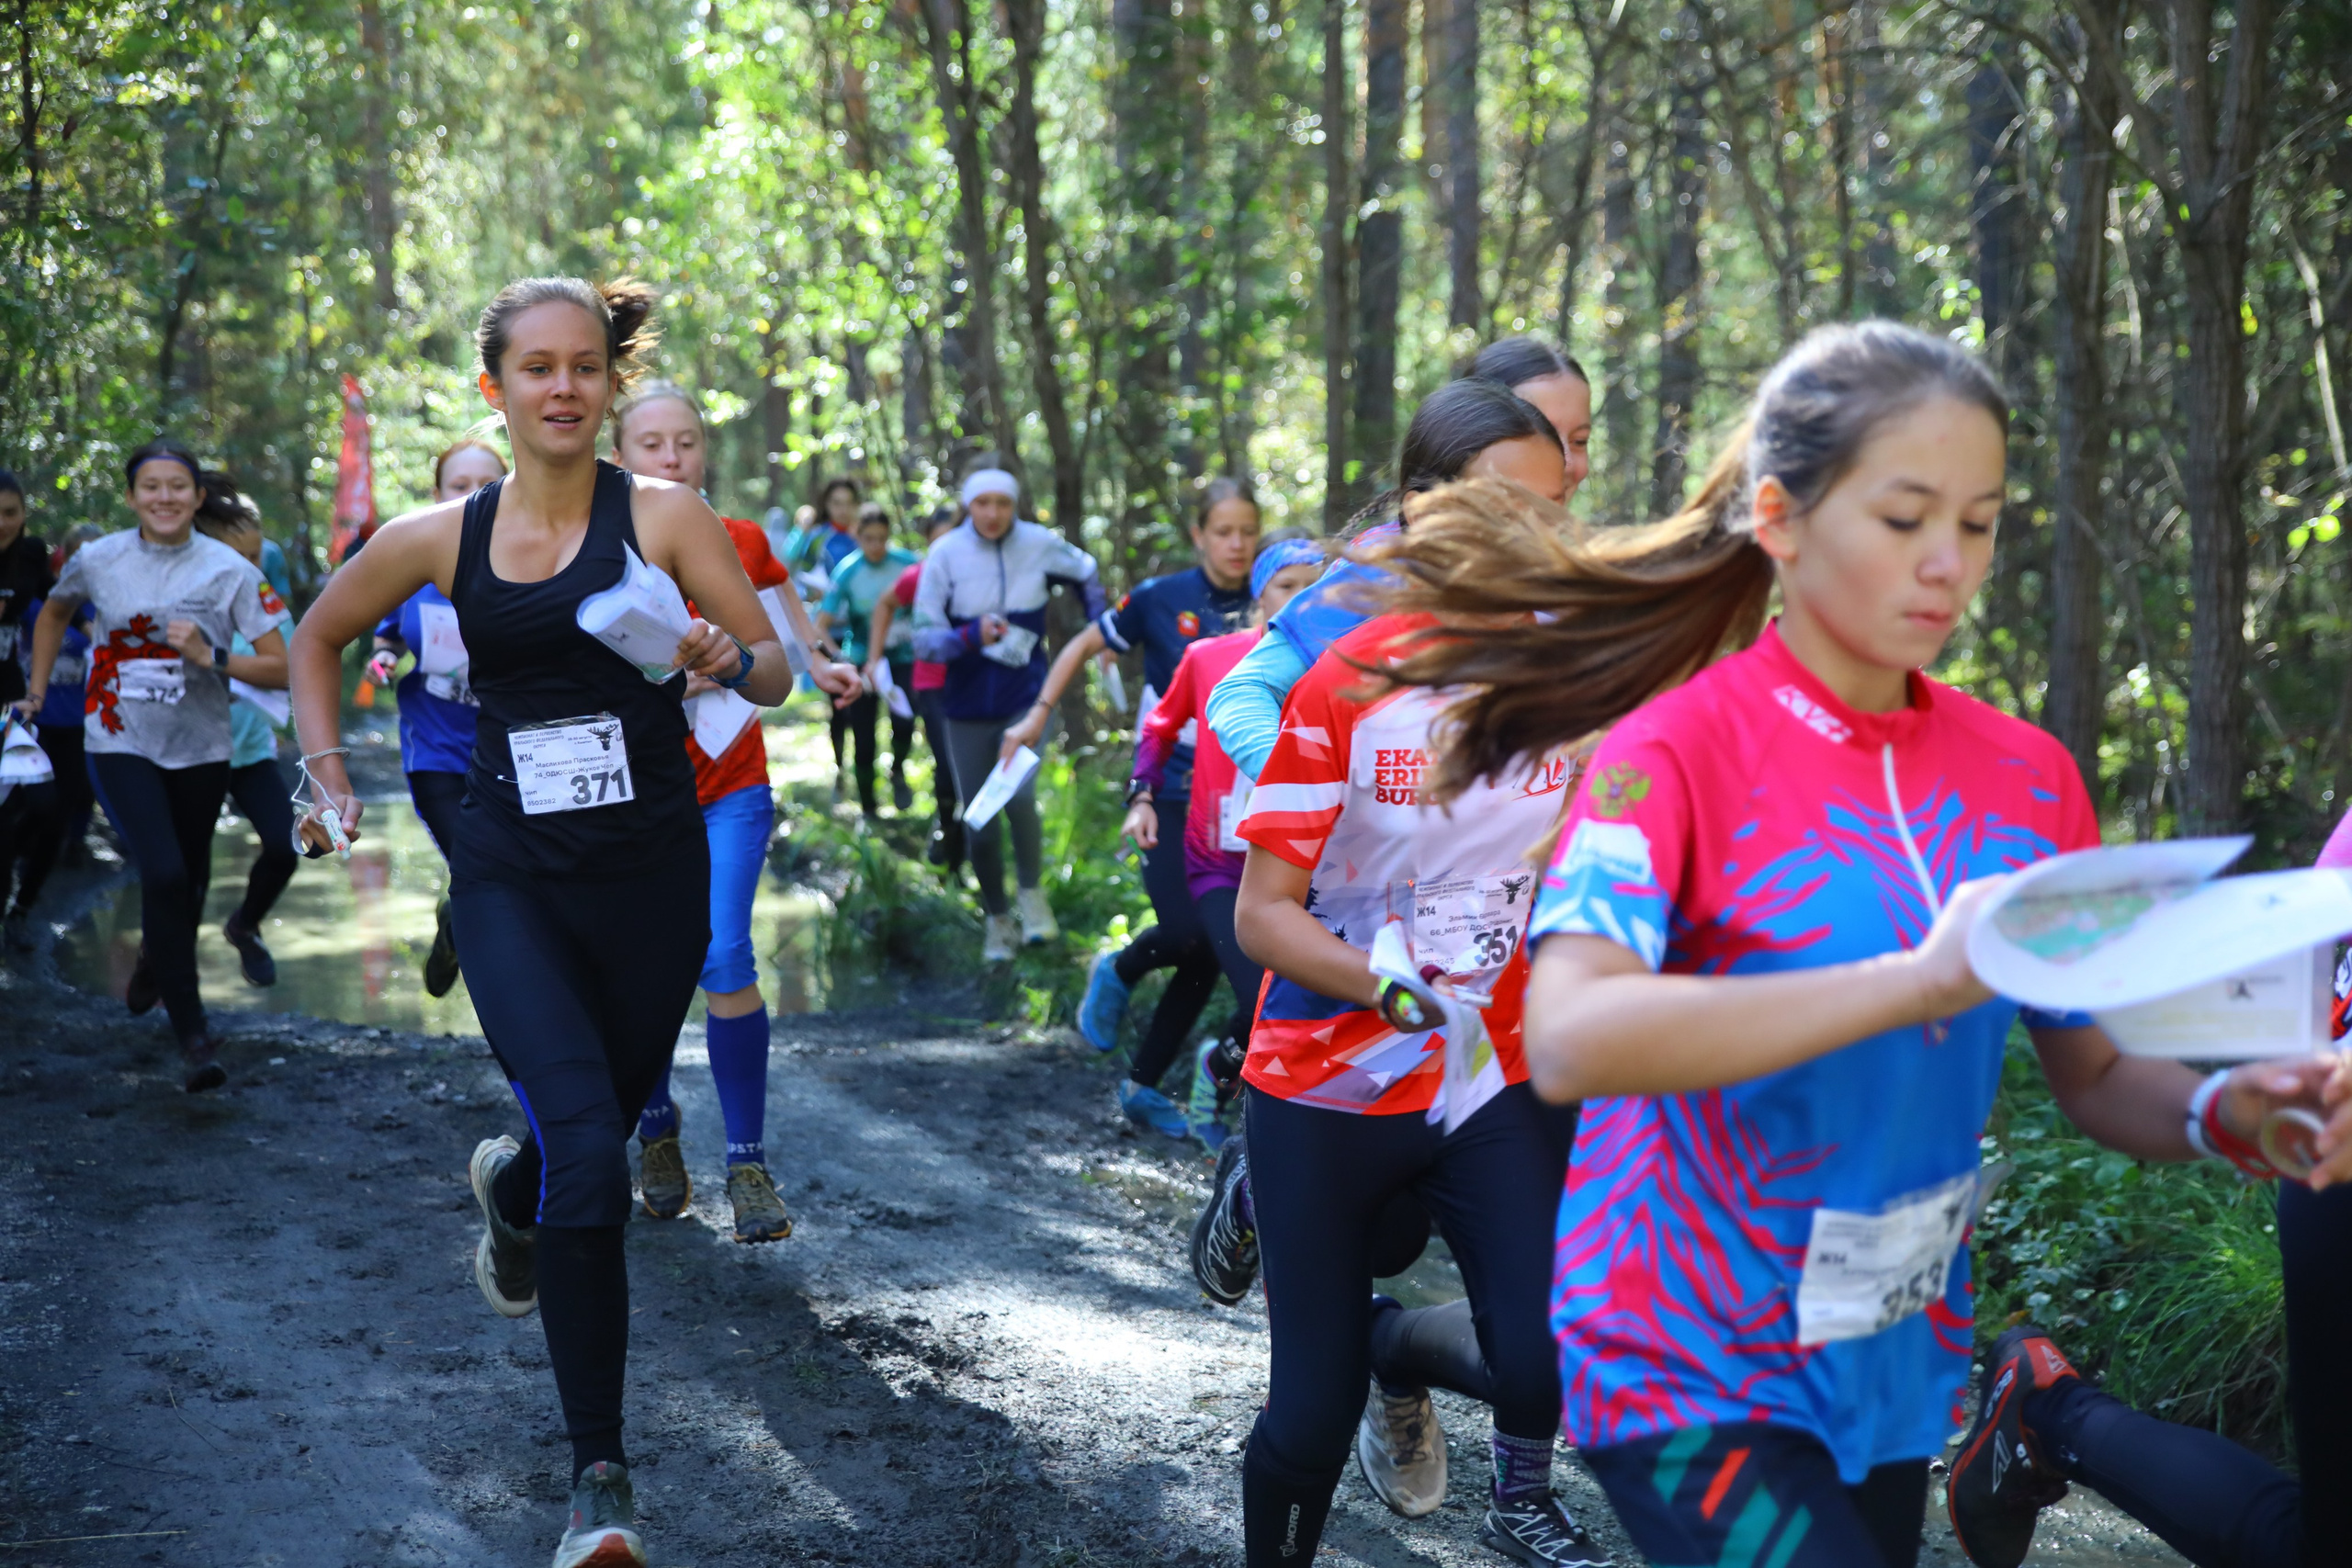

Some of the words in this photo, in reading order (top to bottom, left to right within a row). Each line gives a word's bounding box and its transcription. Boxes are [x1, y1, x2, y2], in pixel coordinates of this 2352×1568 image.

[517, 753, 533, 763] Ж14
[536, 760, 572, 769] Маслихова
[573, 755, 609, 763] Прасковья
[571, 769, 628, 805] 371
[527, 798, 557, 807] 8502382
[1417, 906, 1436, 918] Ж14
[1474, 926, 1518, 967] 351
